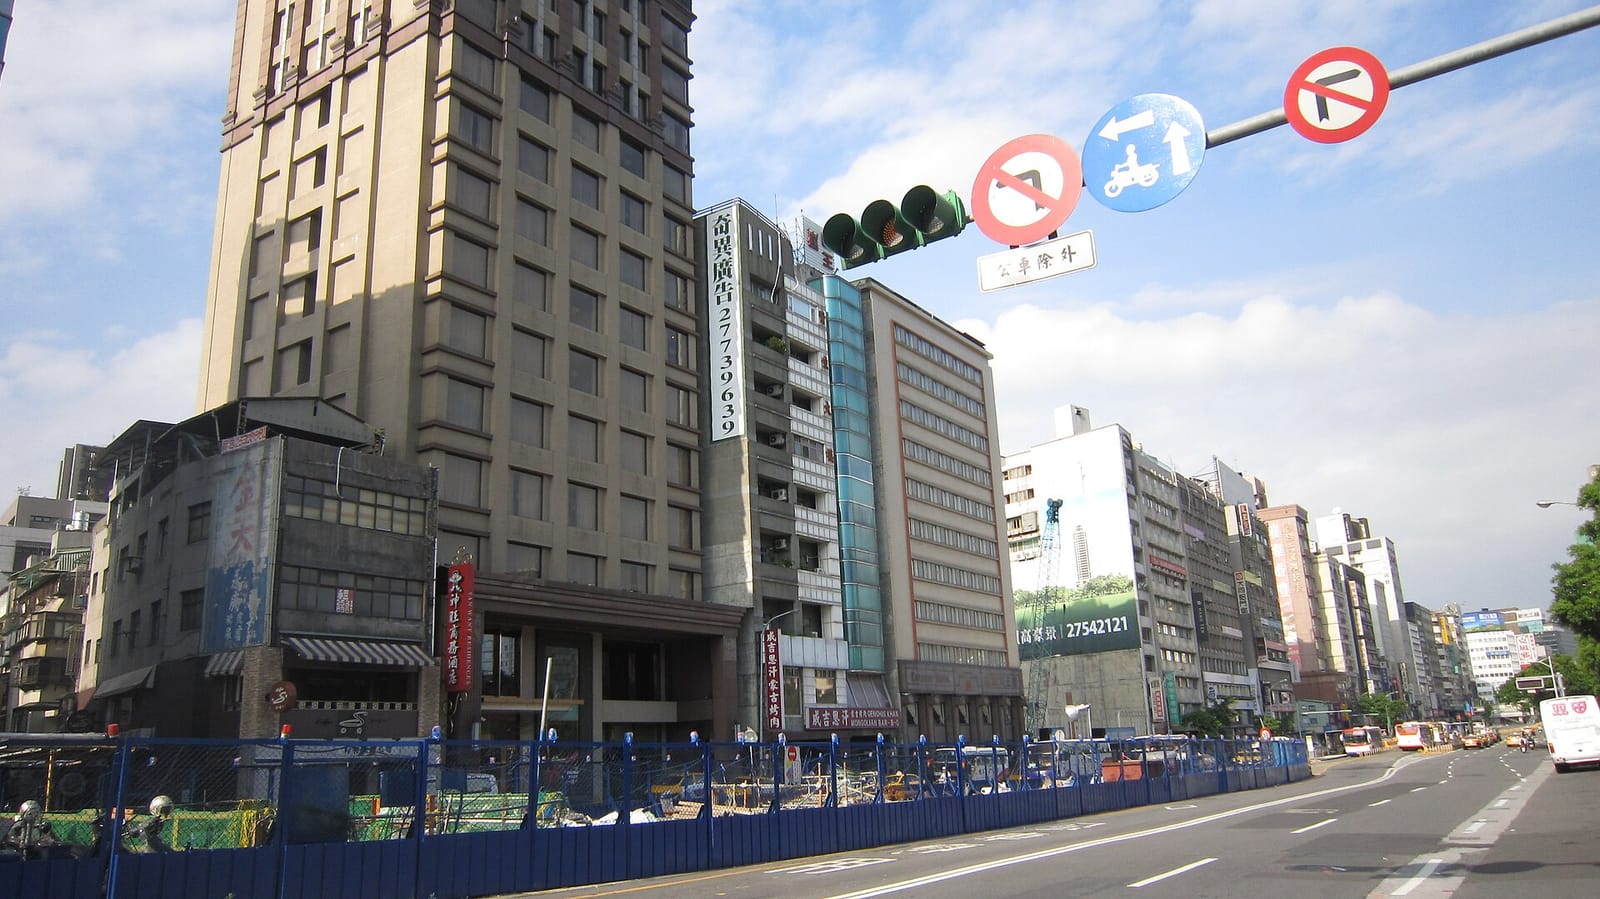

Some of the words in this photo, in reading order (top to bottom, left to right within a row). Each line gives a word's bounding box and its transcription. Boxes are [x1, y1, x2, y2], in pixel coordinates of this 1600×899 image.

[997, 244, 1077, 277] 公車除外
[1066, 616, 1129, 638] 27542121
[766, 631, 780, 728] 成吉思汗蒙古烤肉
[812, 708, 849, 727] 成吉思汗
[850, 719, 877, 727] MONGOLIAN
